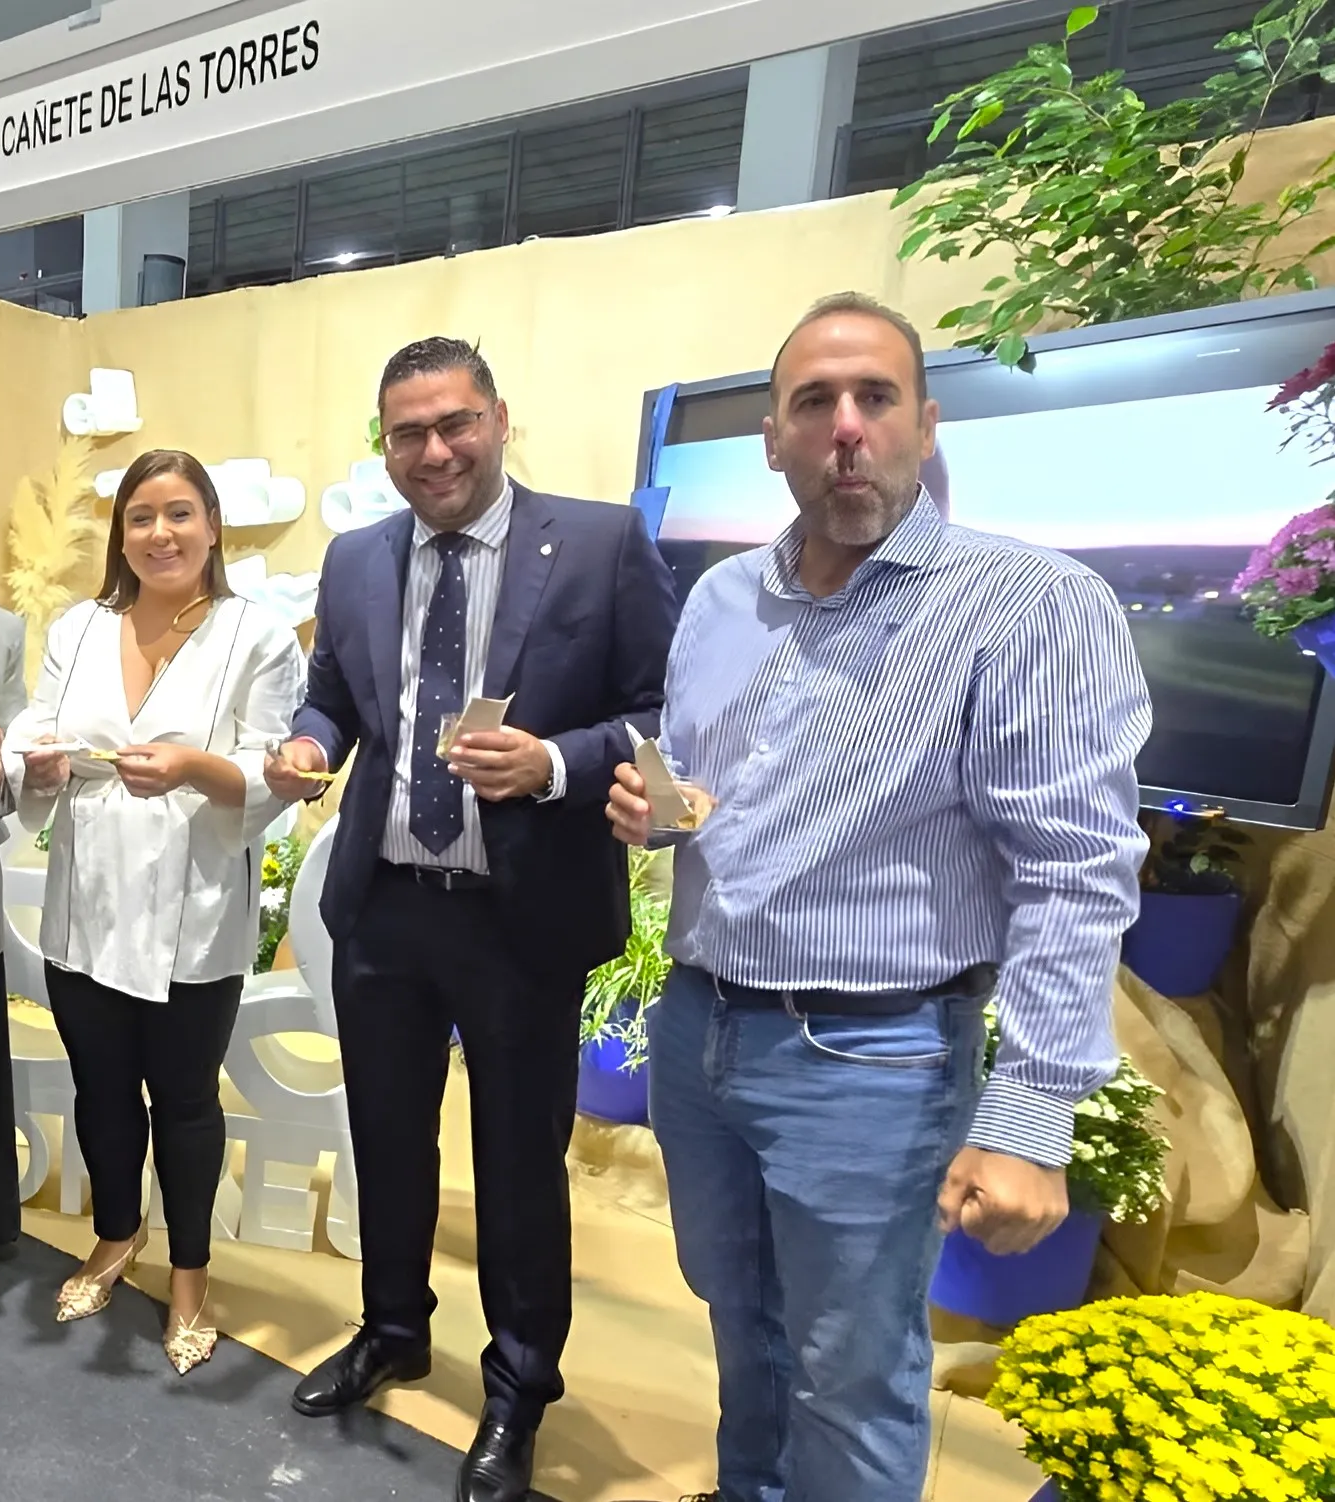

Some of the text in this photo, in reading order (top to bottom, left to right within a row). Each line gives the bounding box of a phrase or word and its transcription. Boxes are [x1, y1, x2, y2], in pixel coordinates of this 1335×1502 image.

[1, 90, 93, 157] CAÑETE
[100, 77, 134, 128] DE
[140, 59, 191, 117] LAS
[199, 19, 320, 100] TORRES
